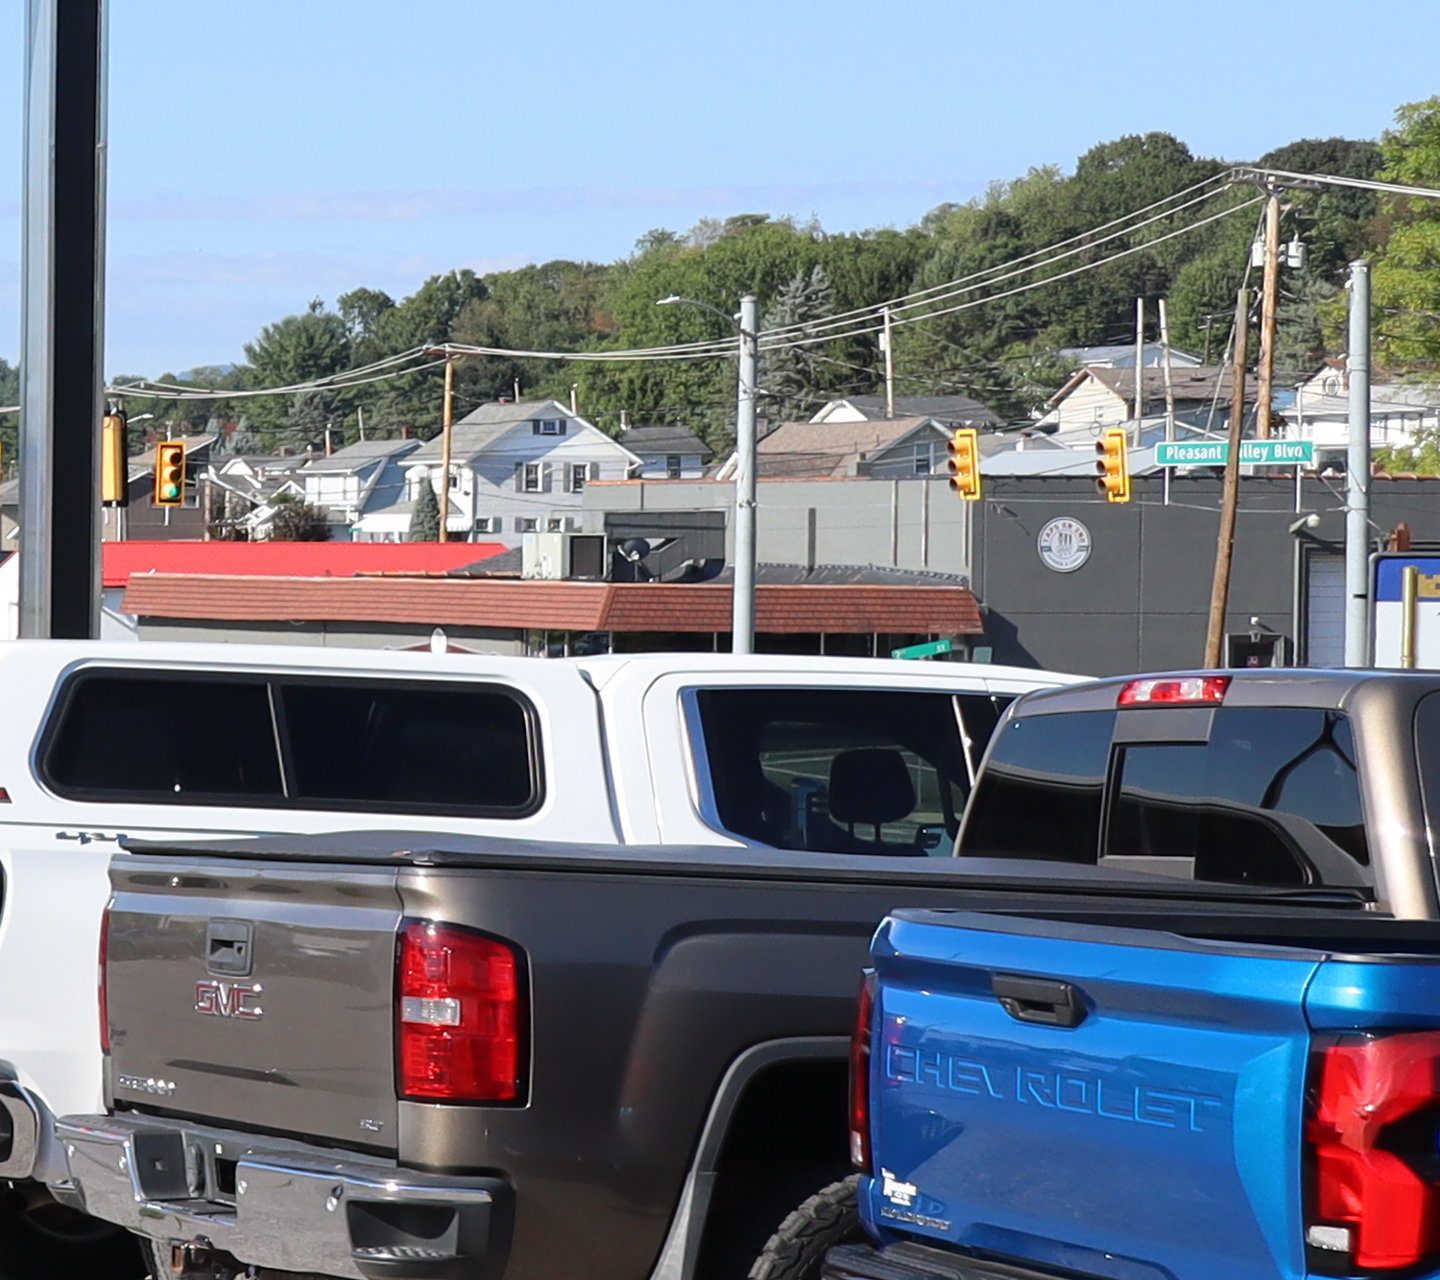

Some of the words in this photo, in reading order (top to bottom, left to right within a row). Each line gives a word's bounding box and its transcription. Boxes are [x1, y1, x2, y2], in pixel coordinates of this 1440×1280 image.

[1166, 446, 1223, 460] Pleasant
[1239, 444, 1270, 462] lley
[194, 979, 264, 1022] GMC
[886, 1044, 1222, 1133] CHEVROLET
